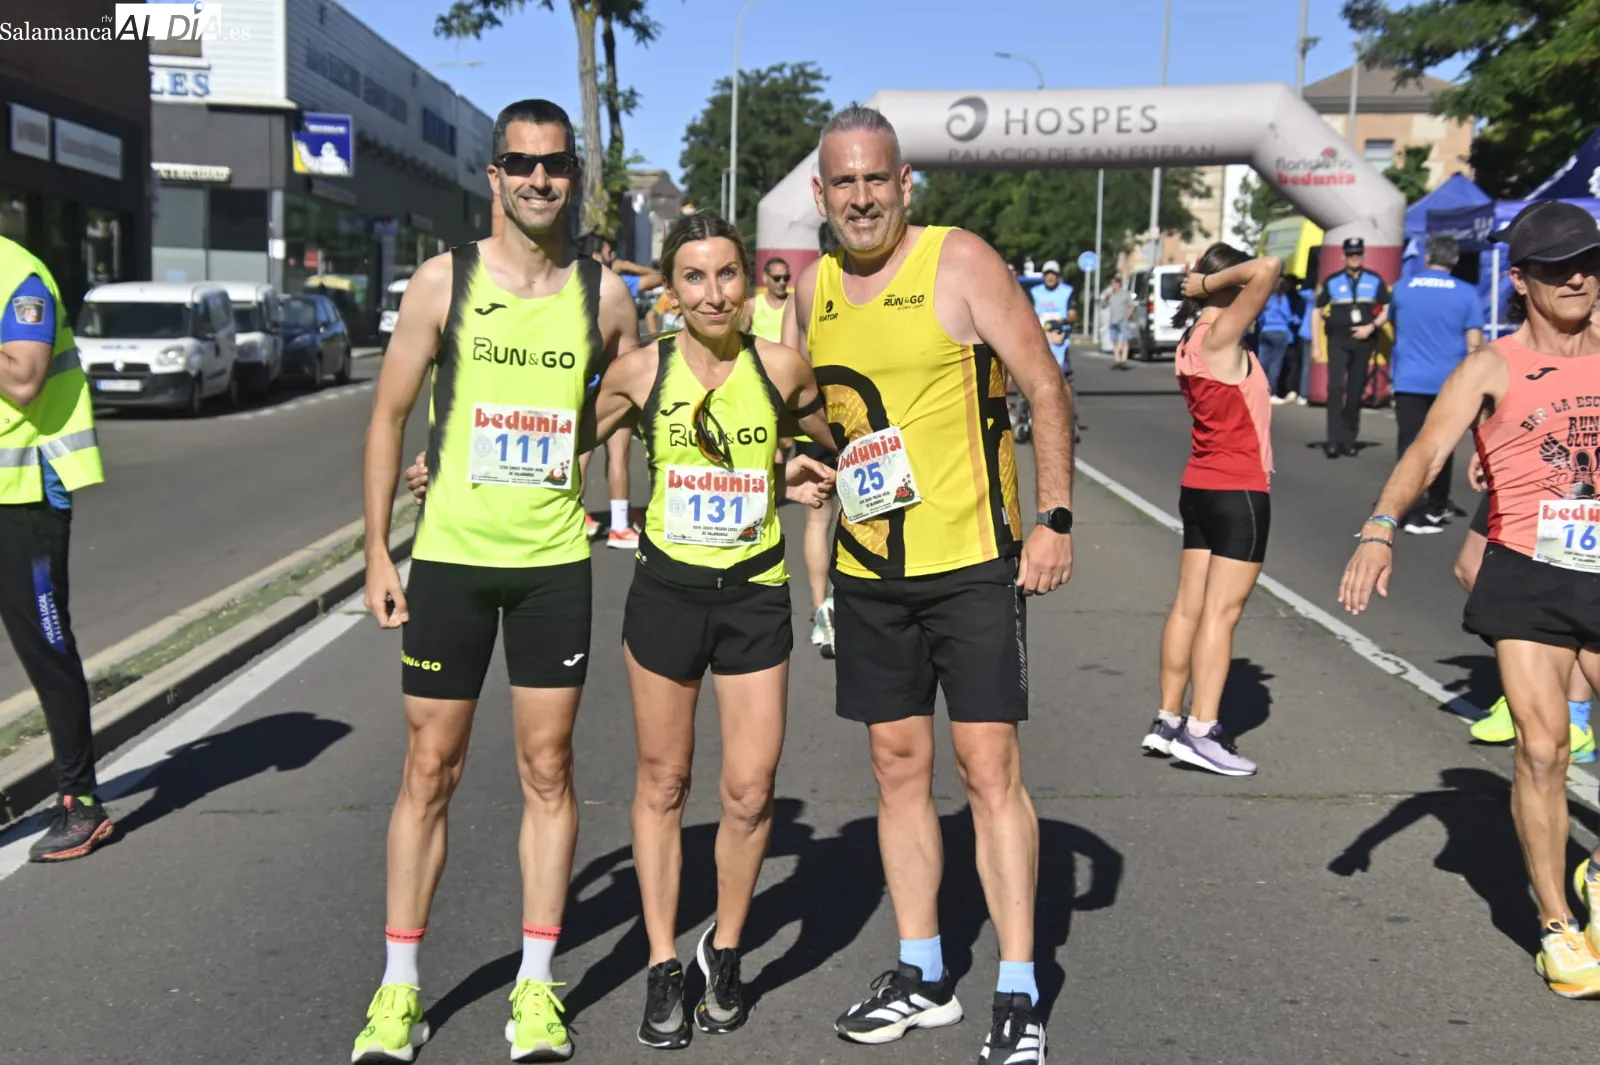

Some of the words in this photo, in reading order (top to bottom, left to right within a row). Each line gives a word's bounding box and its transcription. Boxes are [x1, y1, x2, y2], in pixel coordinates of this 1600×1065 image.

[1004, 105, 1158, 136] HOSPES
[948, 147, 1040, 163] PALACIO
[1047, 147, 1076, 162] DE
[1081, 146, 1121, 162] SAN
[1129, 144, 1216, 161] ESTEBAN
[1277, 169, 1356, 187] bedunia
[1551, 399, 1571, 413] LA
[475, 408, 572, 434] bedunia
[495, 433, 551, 465] 111
[1567, 433, 1598, 447] CLUB
[839, 435, 902, 472] bedunia
[668, 469, 765, 494] bedunia
[853, 461, 884, 497] 25
[688, 494, 744, 525] 131
[1563, 524, 1597, 551] 16
[401, 650, 442, 671] UN&GO
